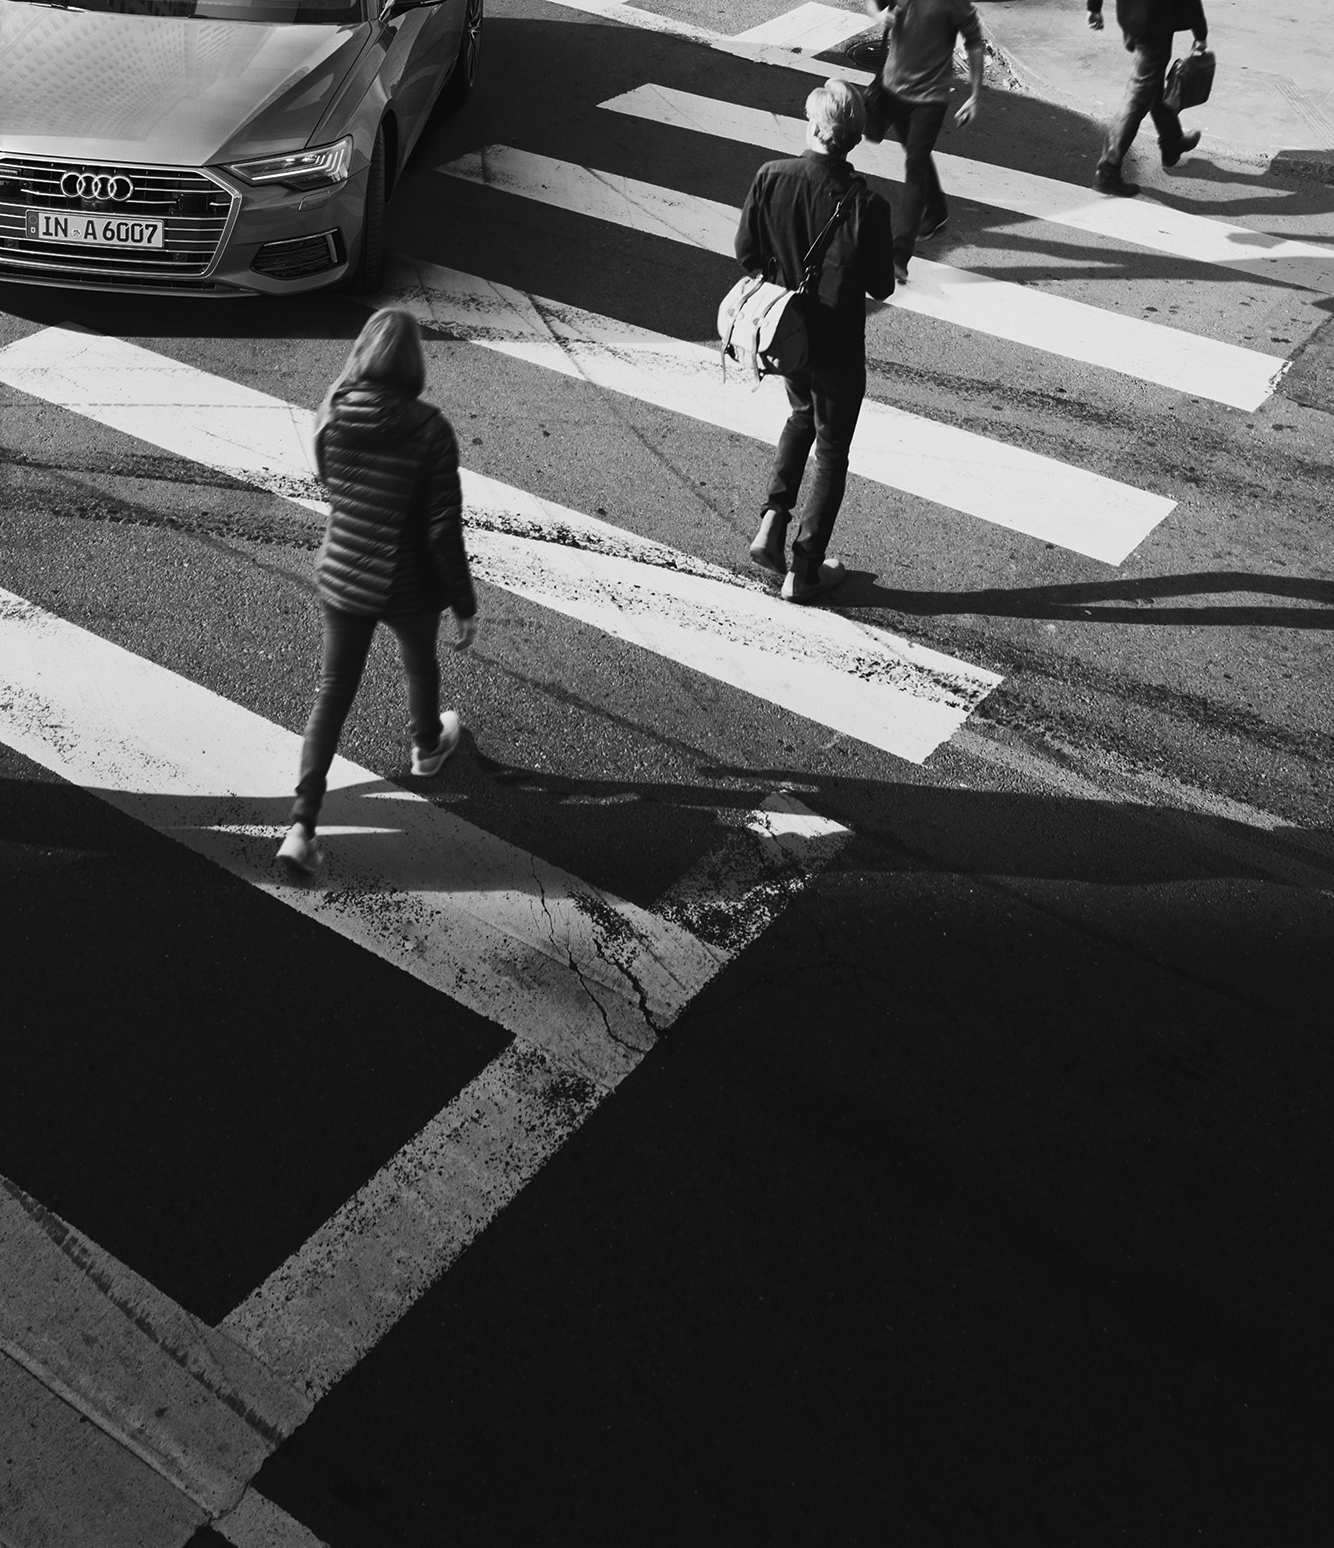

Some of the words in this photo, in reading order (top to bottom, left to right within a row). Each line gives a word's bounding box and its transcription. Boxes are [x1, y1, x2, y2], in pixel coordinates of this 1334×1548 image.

[42, 216, 68, 238] IN
[83, 220, 97, 240] A
[102, 221, 158, 244] 6007
